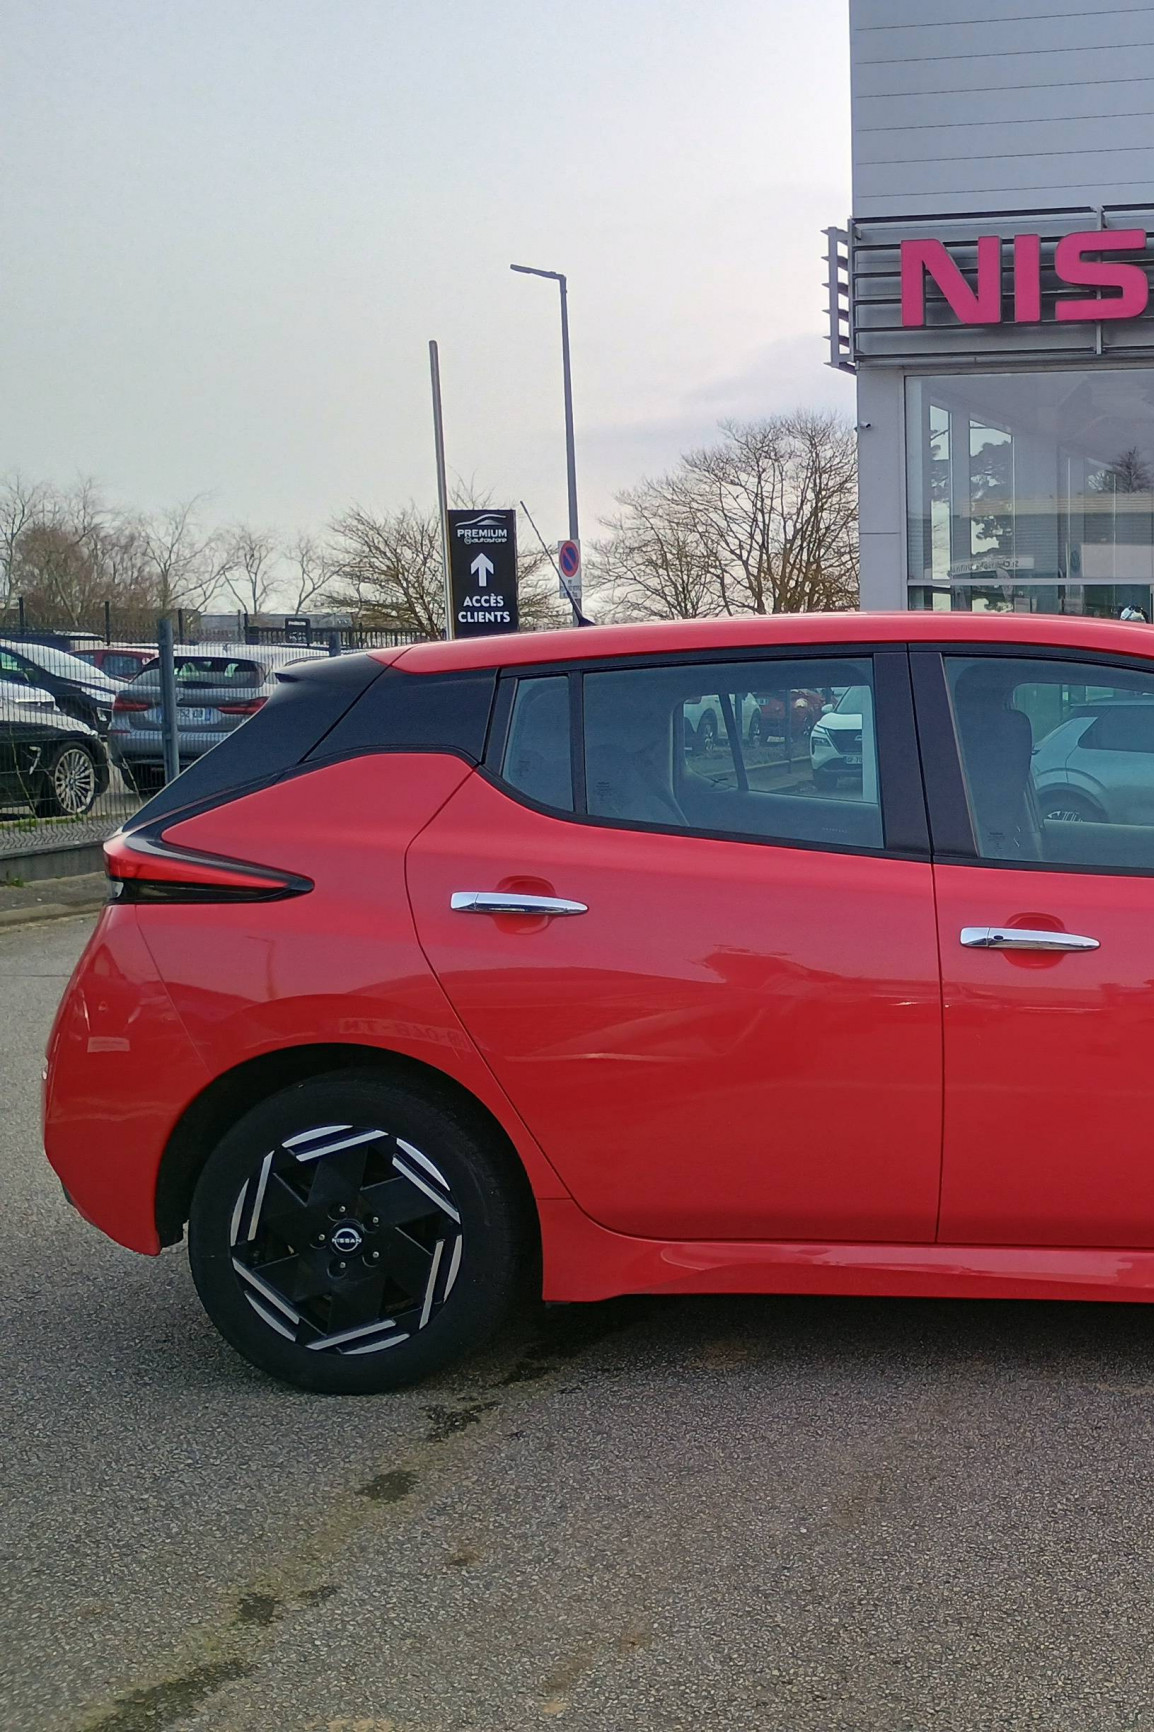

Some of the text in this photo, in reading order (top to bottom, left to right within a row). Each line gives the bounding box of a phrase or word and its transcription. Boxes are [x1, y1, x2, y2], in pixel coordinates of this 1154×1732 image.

[457, 529, 507, 537] PREMIUM
[463, 593, 504, 607] ACCÈS
[458, 611, 511, 623] CLIENTS
